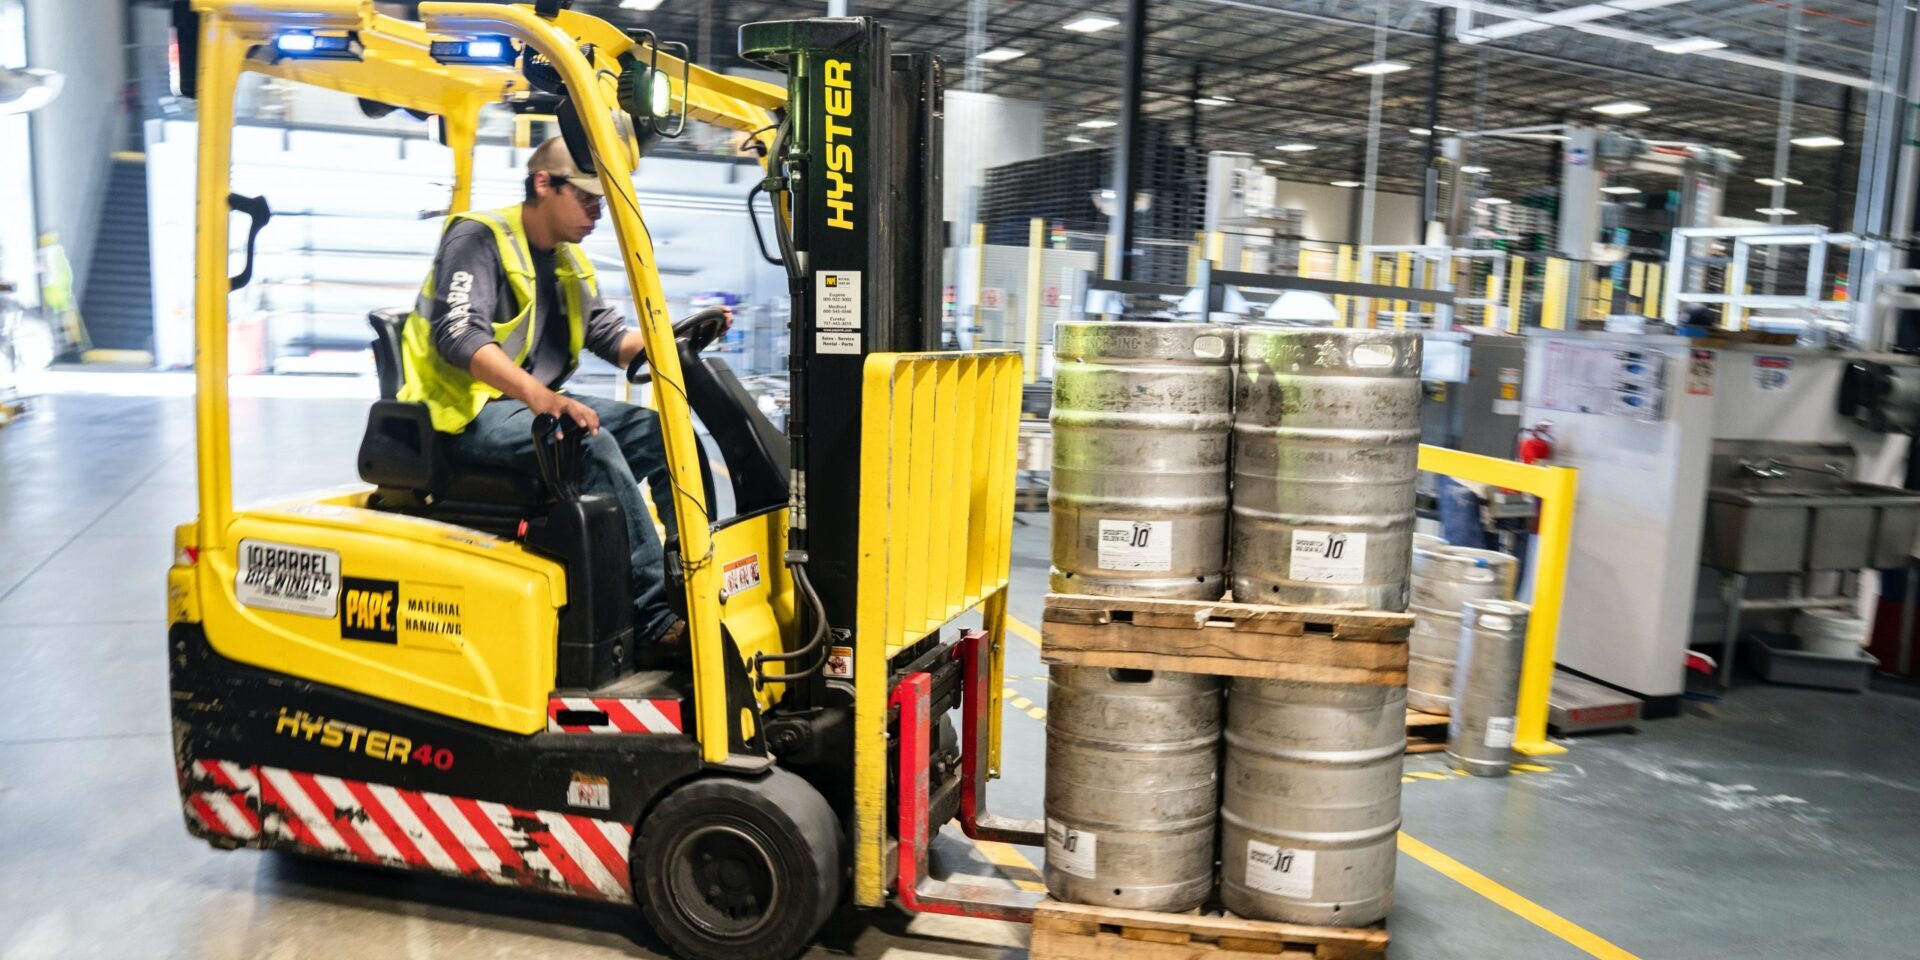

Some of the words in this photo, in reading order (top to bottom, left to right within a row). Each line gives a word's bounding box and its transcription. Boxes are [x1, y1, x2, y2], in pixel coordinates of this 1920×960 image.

[824, 59, 853, 230] HYSTER
[1129, 526, 1149, 547] 10
[1323, 537, 1344, 559] 10
[408, 599, 461, 617] MATERIAL
[405, 618, 462, 635] HANDLING
[276, 706, 412, 765] HYSTER
[412, 744, 454, 771] 40
